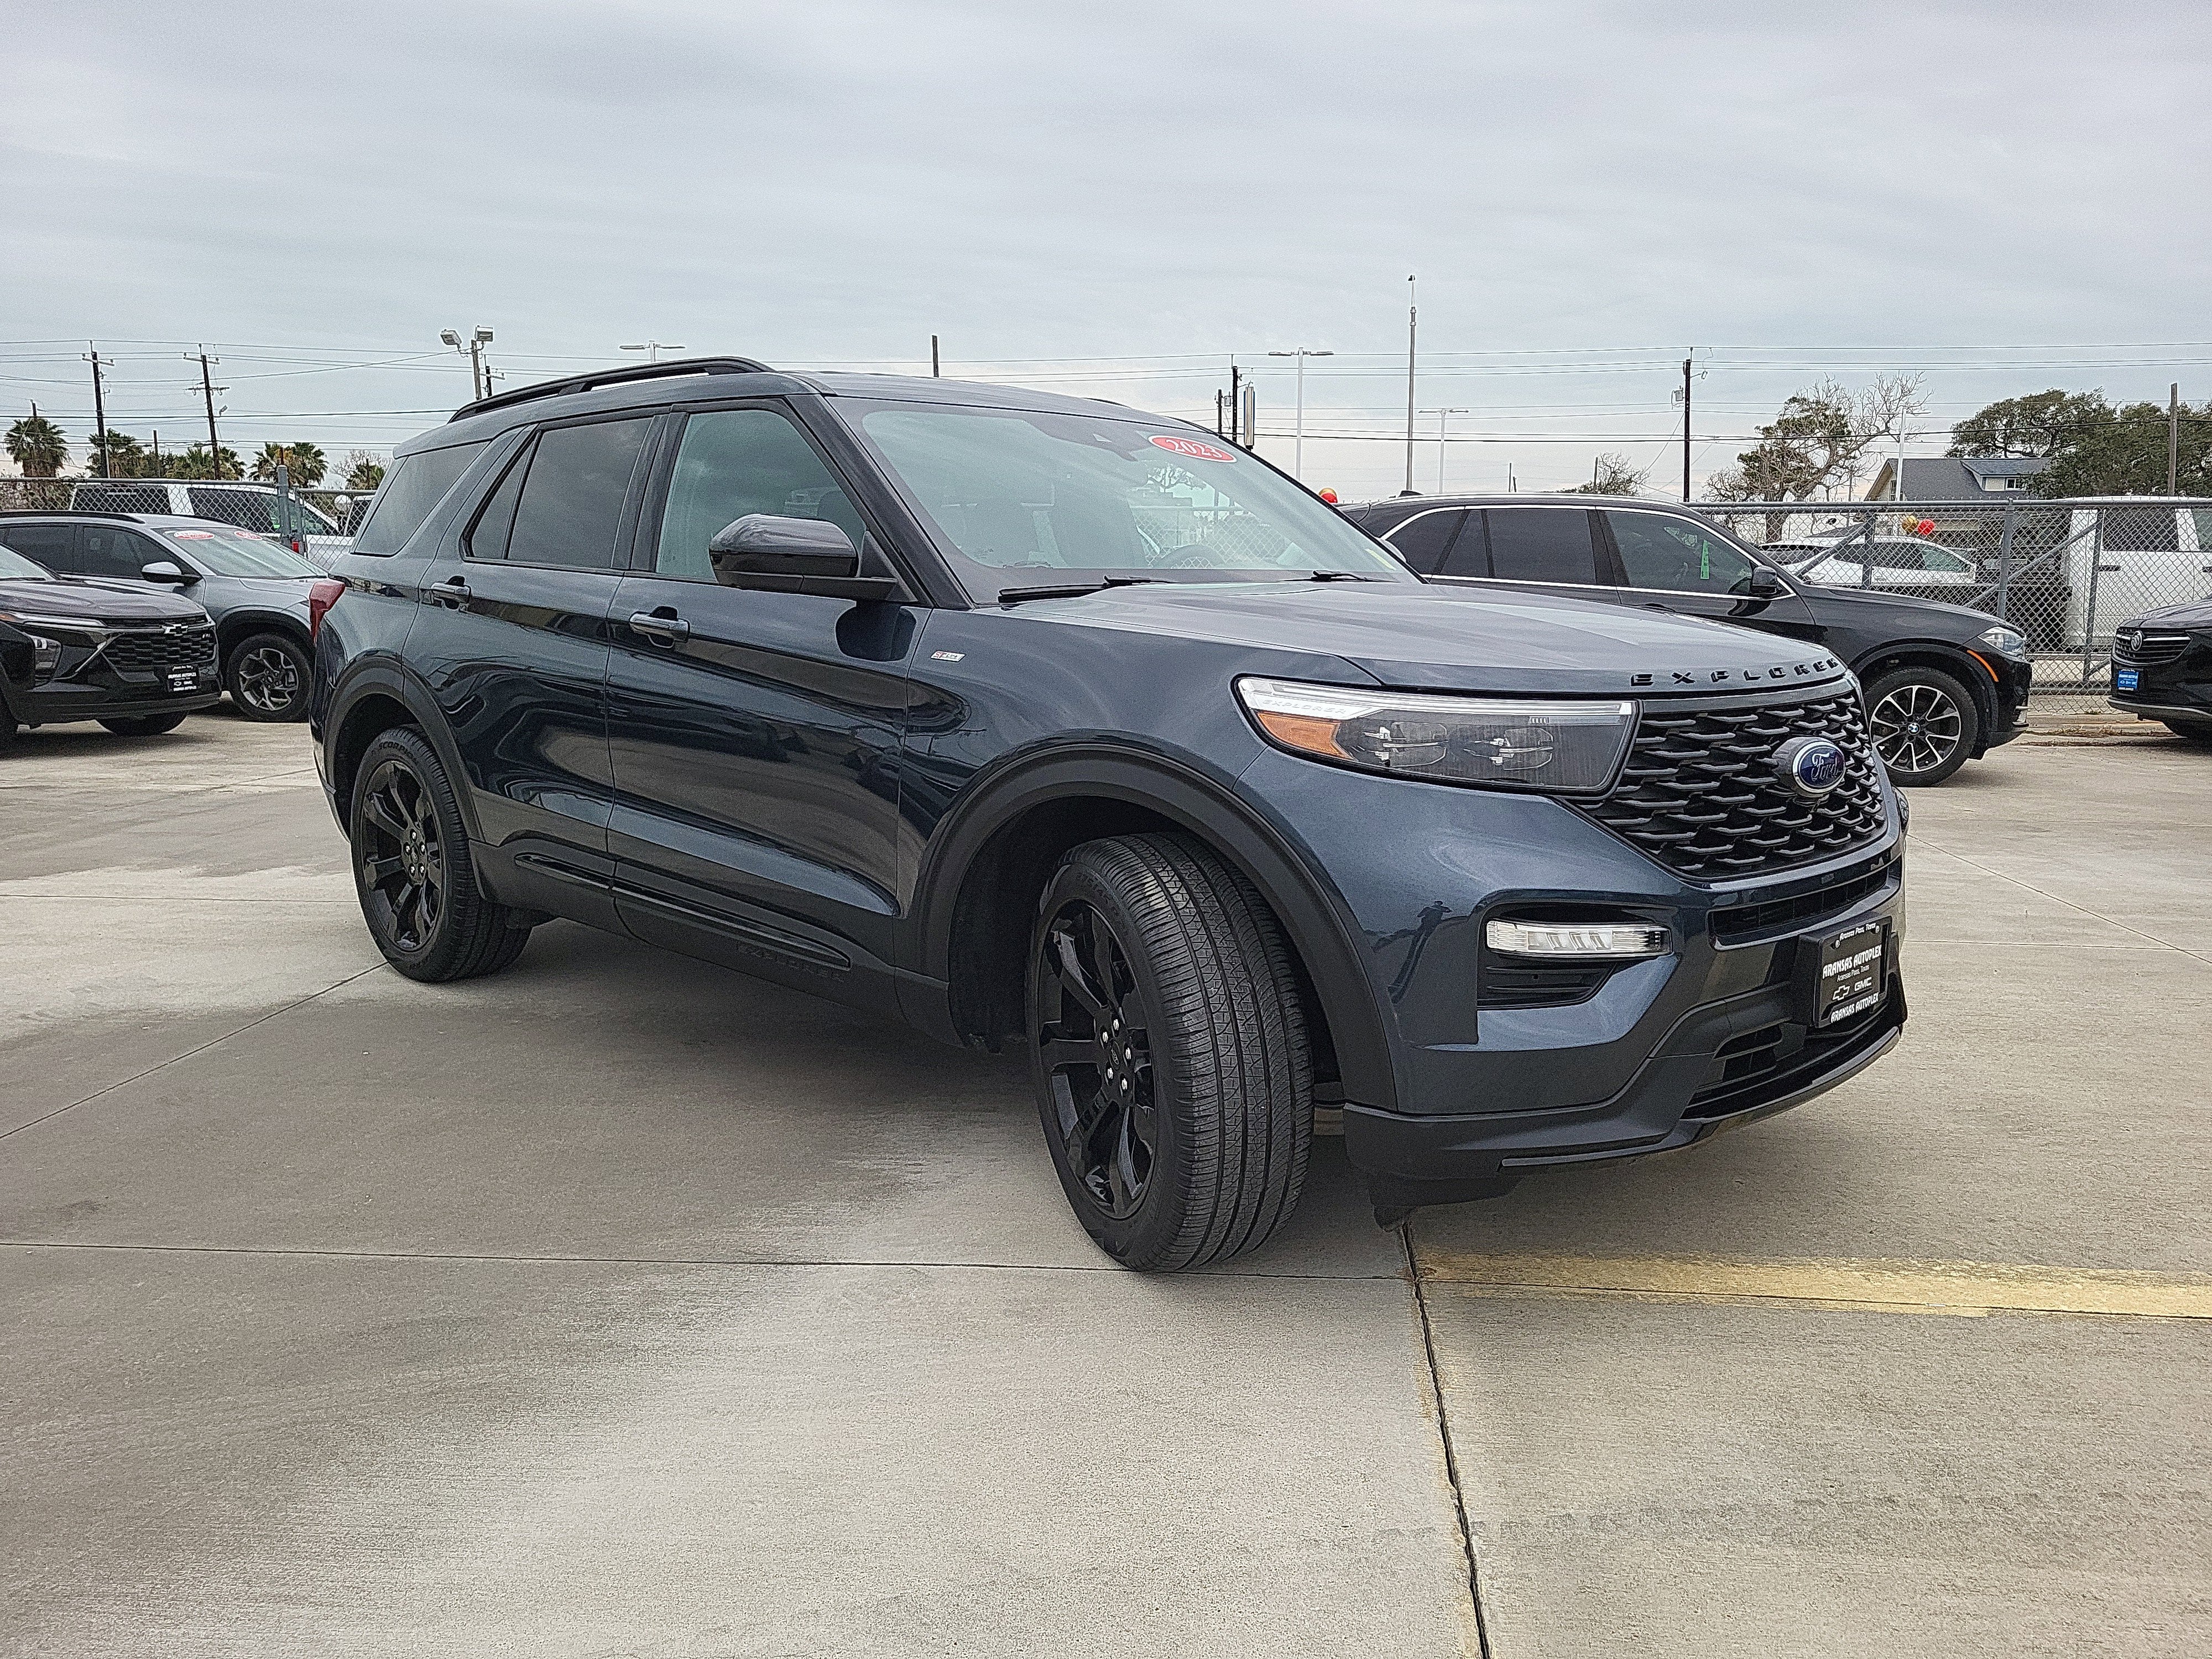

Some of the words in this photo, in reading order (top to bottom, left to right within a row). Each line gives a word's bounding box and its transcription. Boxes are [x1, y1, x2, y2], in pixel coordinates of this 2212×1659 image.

[1166, 439, 1223, 458] 2023
[1630, 657, 1840, 687] EXPLORER
[1262, 699, 1347, 714] EXPLORER
[1811, 752, 1843, 781] Ford
[1822, 956, 1852, 979] ARANSAS
[1853, 945, 1882, 967] AUTOPLEX
[1854, 977, 1872, 992] GMC
[1830, 1003, 1855, 1023] ARANSAS
[1855, 992, 1879, 1013] AUTOPLEX
